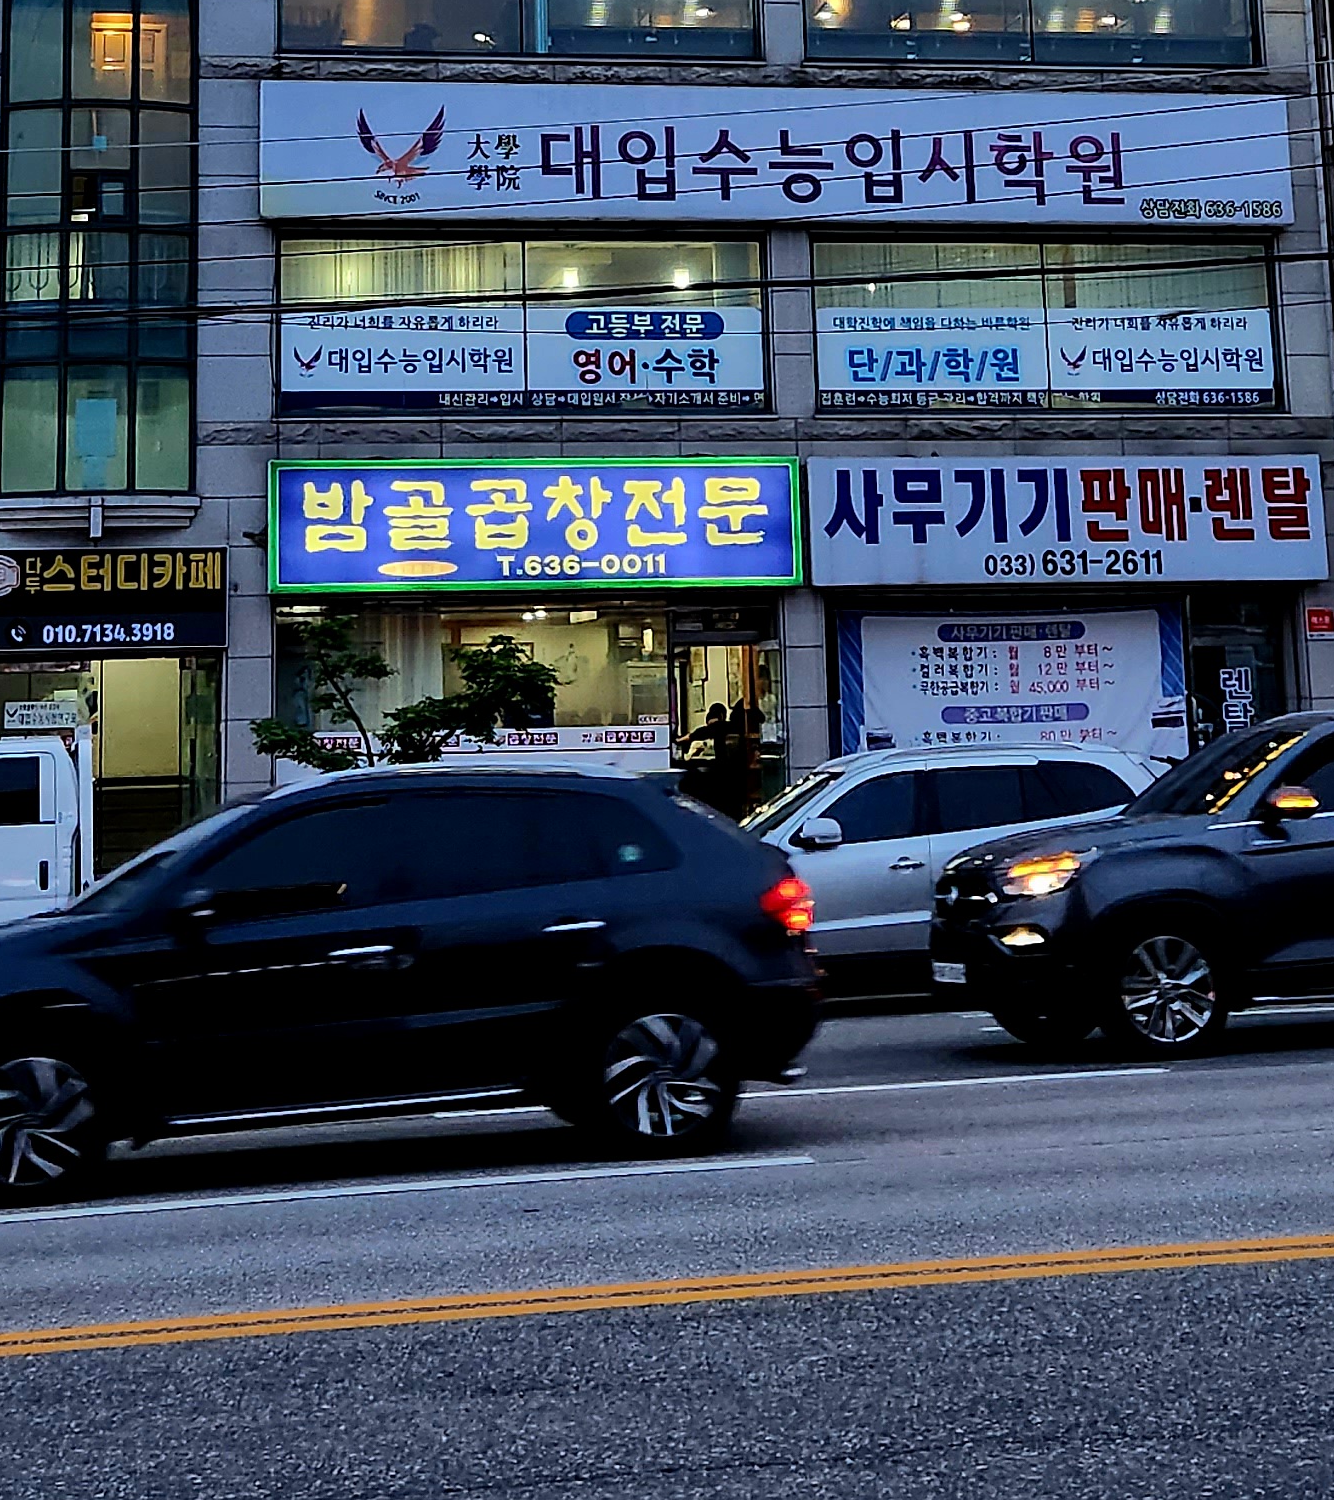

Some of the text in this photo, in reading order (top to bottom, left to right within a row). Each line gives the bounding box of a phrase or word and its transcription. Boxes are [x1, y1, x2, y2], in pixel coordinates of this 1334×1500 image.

[540, 124, 1125, 205] 대입수능입시학원
[1140, 199, 1283, 219] 상담전화 636-1586
[458, 315, 499, 329] 하리라
[585, 314, 706, 337] 고등부 전문
[327, 347, 514, 374] 대입수능입시학원
[1092, 347, 1264, 372] 대입수능입시학원
[500, 393, 523, 406] 입시
[531, 393, 558, 406] 상담
[717, 392, 741, 405] 준비
[1203, 392, 1259, 403] 636-1586
[42, 553, 221, 592] 스터디카페
[496, 554, 667, 577] T.636-0011
[984, 549, 1164, 577] 033) 631-2611
[43, 622, 175, 643] 010.7134.3918
[1028, 681, 1070, 695] 45,000
[1220, 667, 1254, 734] 렌탈
